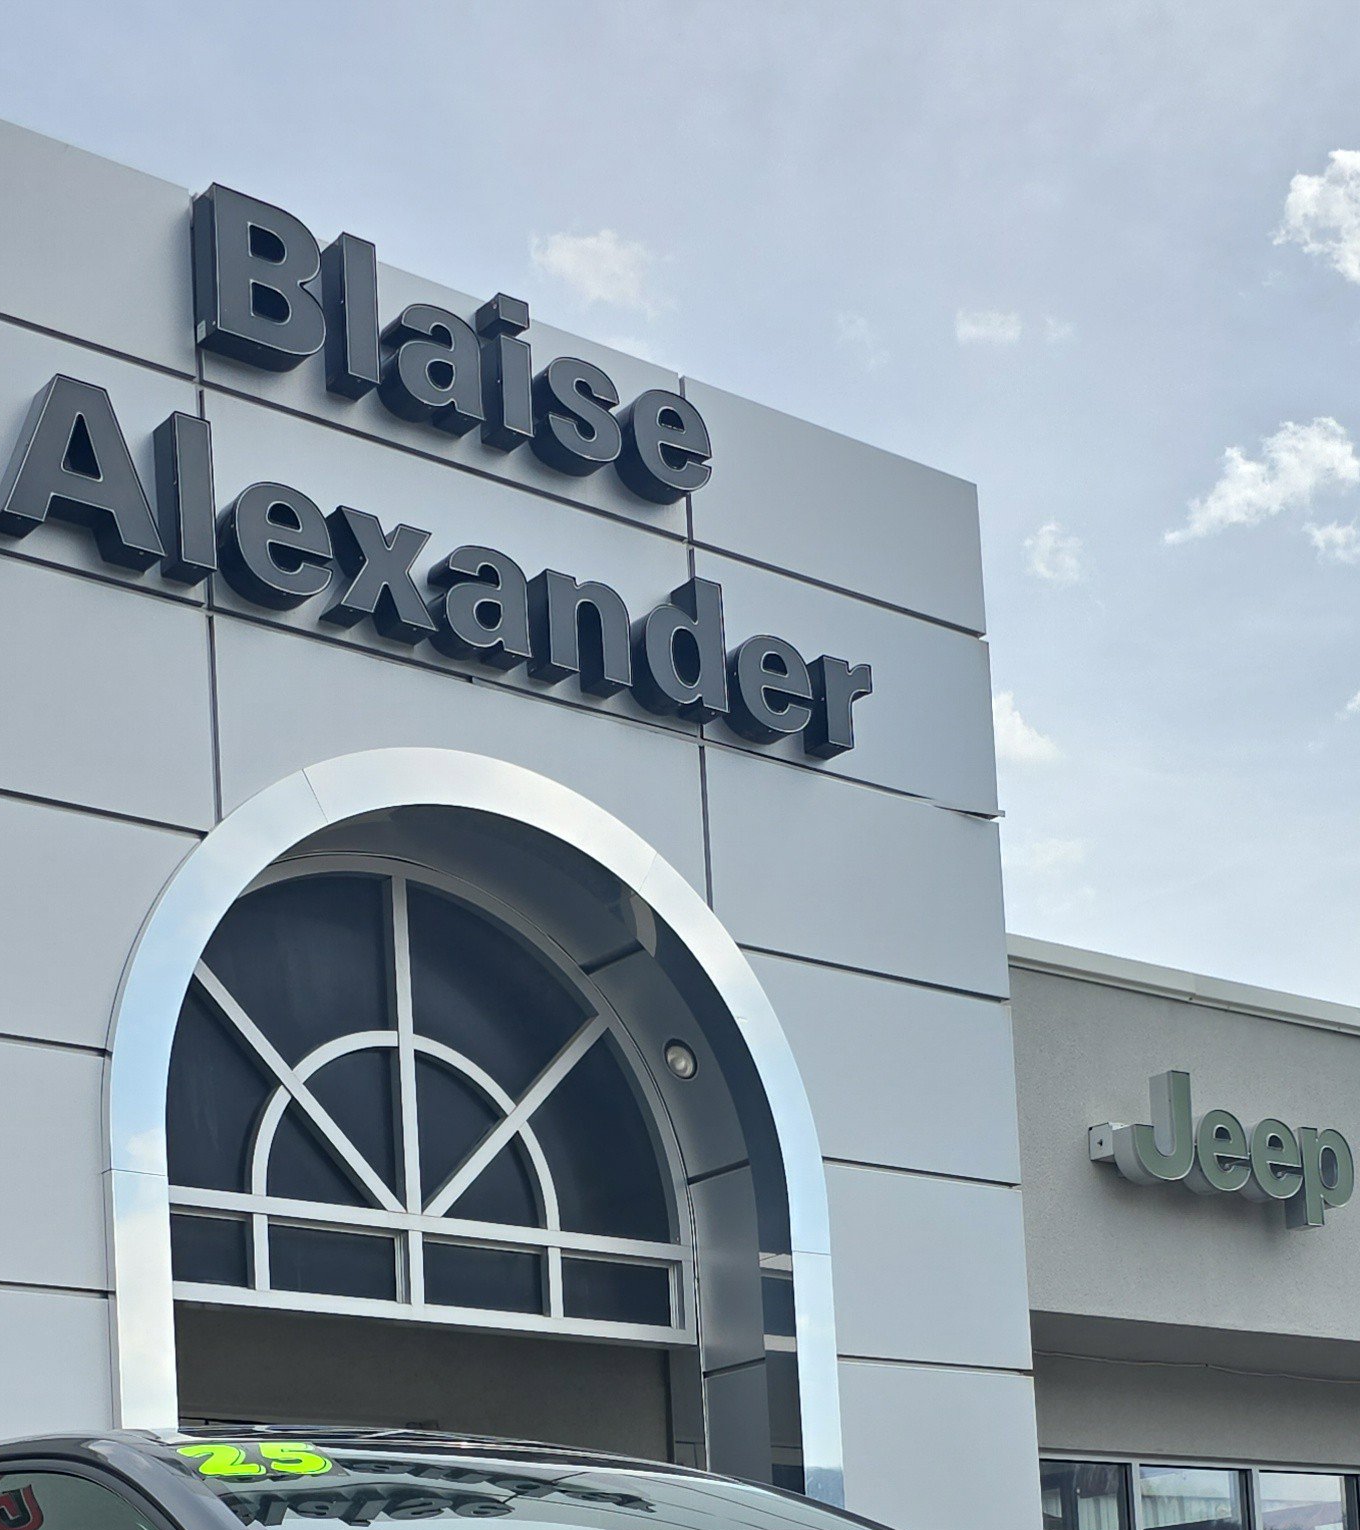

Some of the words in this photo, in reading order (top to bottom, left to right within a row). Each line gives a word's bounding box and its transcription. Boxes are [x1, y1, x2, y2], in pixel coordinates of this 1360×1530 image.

[191, 182, 713, 505] Blaise
[1113, 1069, 1355, 1230] Jeep
[176, 1442, 333, 1477] 25
